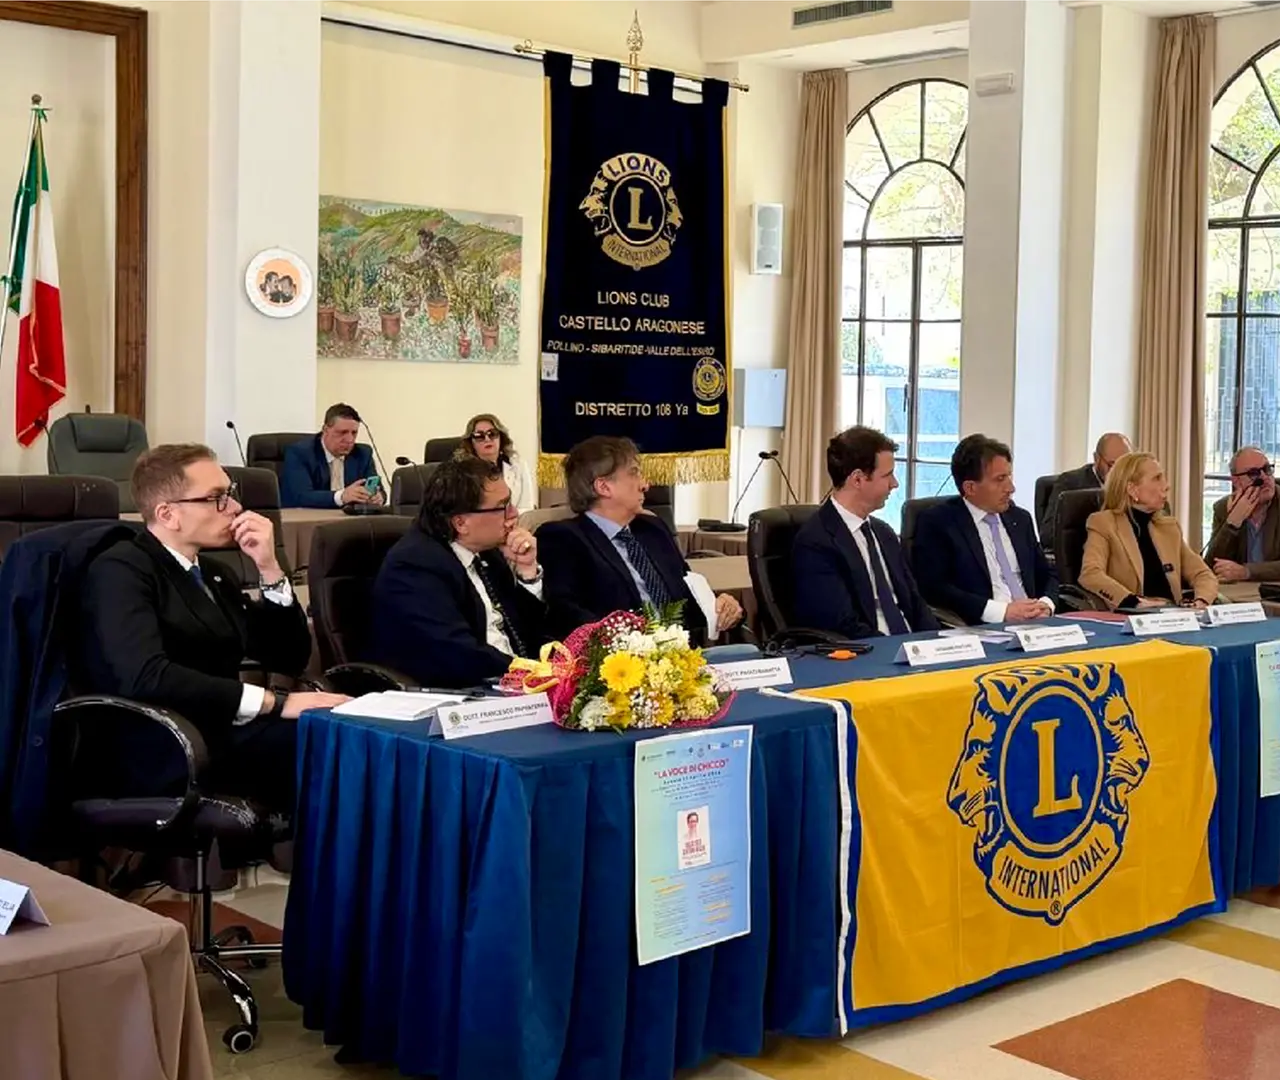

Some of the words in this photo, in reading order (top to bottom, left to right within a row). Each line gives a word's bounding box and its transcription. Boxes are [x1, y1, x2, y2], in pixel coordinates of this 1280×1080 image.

[607, 156, 668, 183] LIONS
[627, 187, 653, 230] L
[597, 291, 637, 305] LIONS
[640, 293, 669, 307] CLUB
[559, 315, 631, 331] CASTELLO
[635, 319, 705, 335] ARAGONESE
[547, 340, 584, 353] POLLINO
[575, 402, 651, 416] DISTRETTO
[655, 403, 671, 416] 108
[675, 403, 689, 416] Ya
[1031, 718, 1082, 818] L
[999, 837, 1111, 900] INTERNATIONAL
